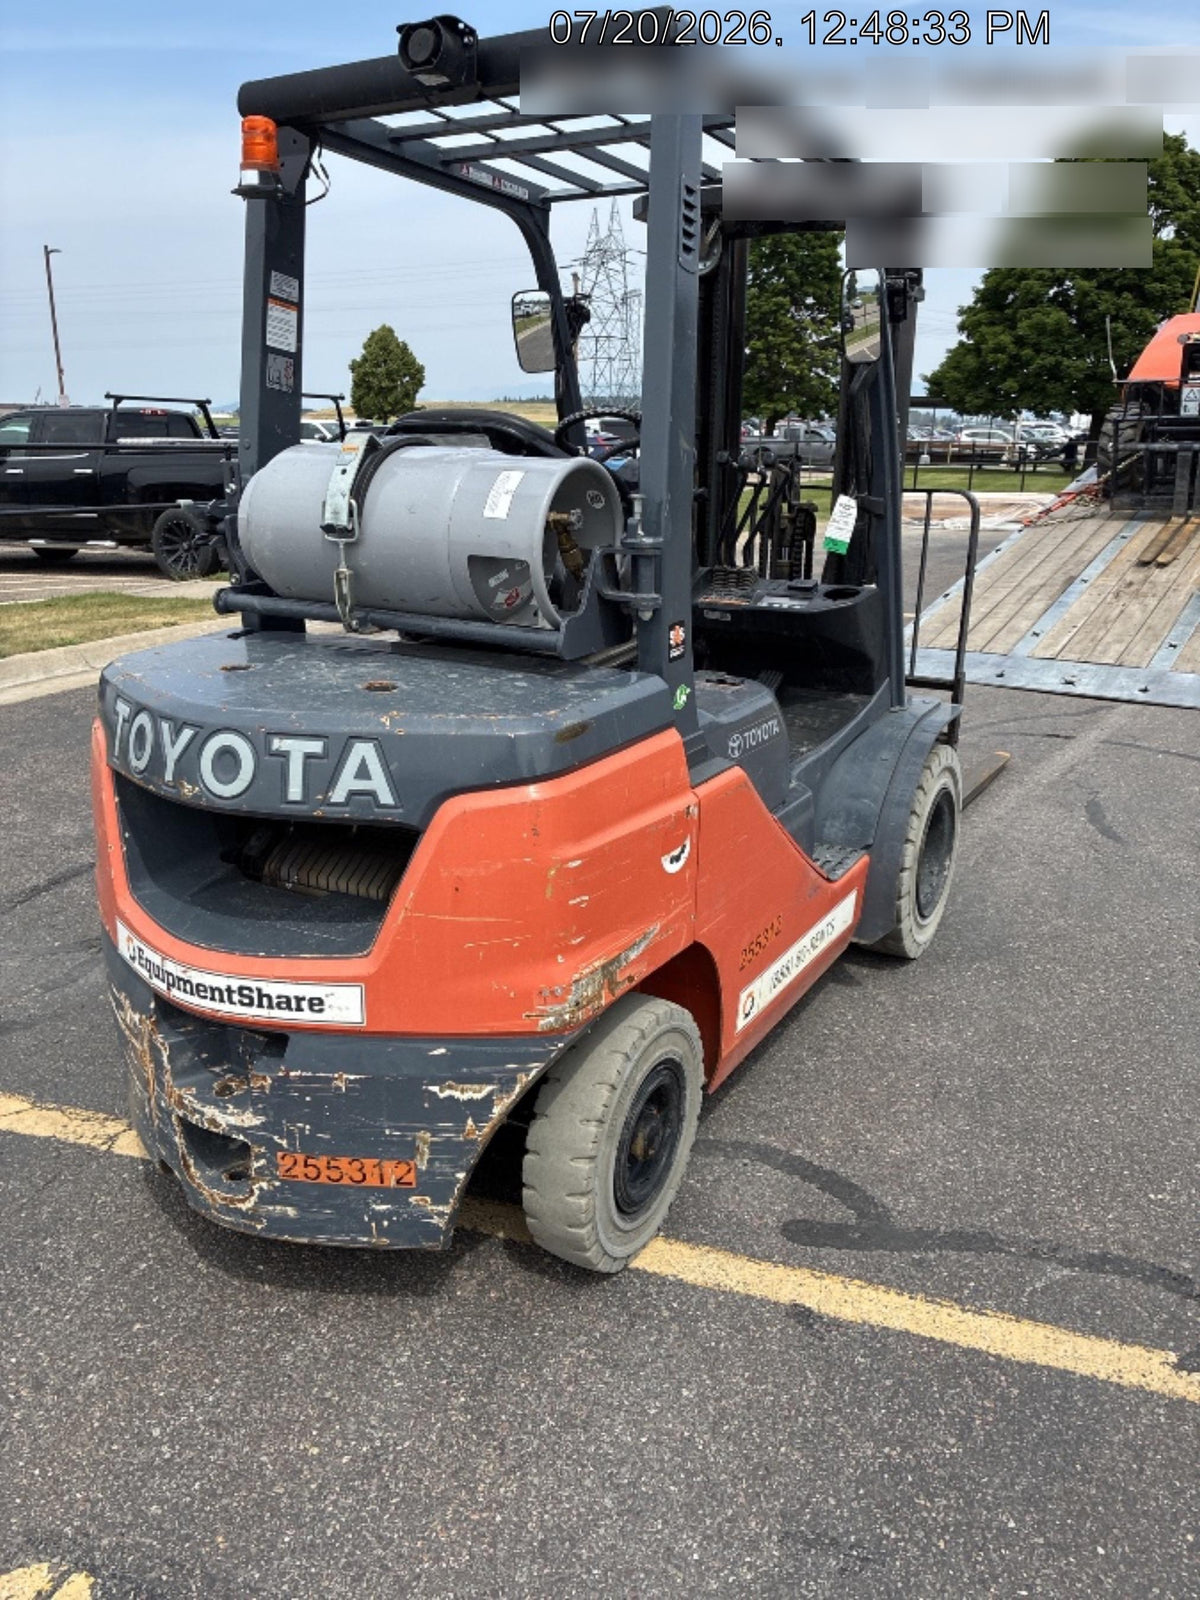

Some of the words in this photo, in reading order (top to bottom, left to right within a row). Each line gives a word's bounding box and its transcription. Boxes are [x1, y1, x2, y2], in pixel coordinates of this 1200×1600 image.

[113, 699, 397, 806] TOYOTA
[744, 719, 780, 749] TOYOTA
[137, 946, 325, 1014] EquipmentShare
[280, 1153, 414, 1186] 255312
